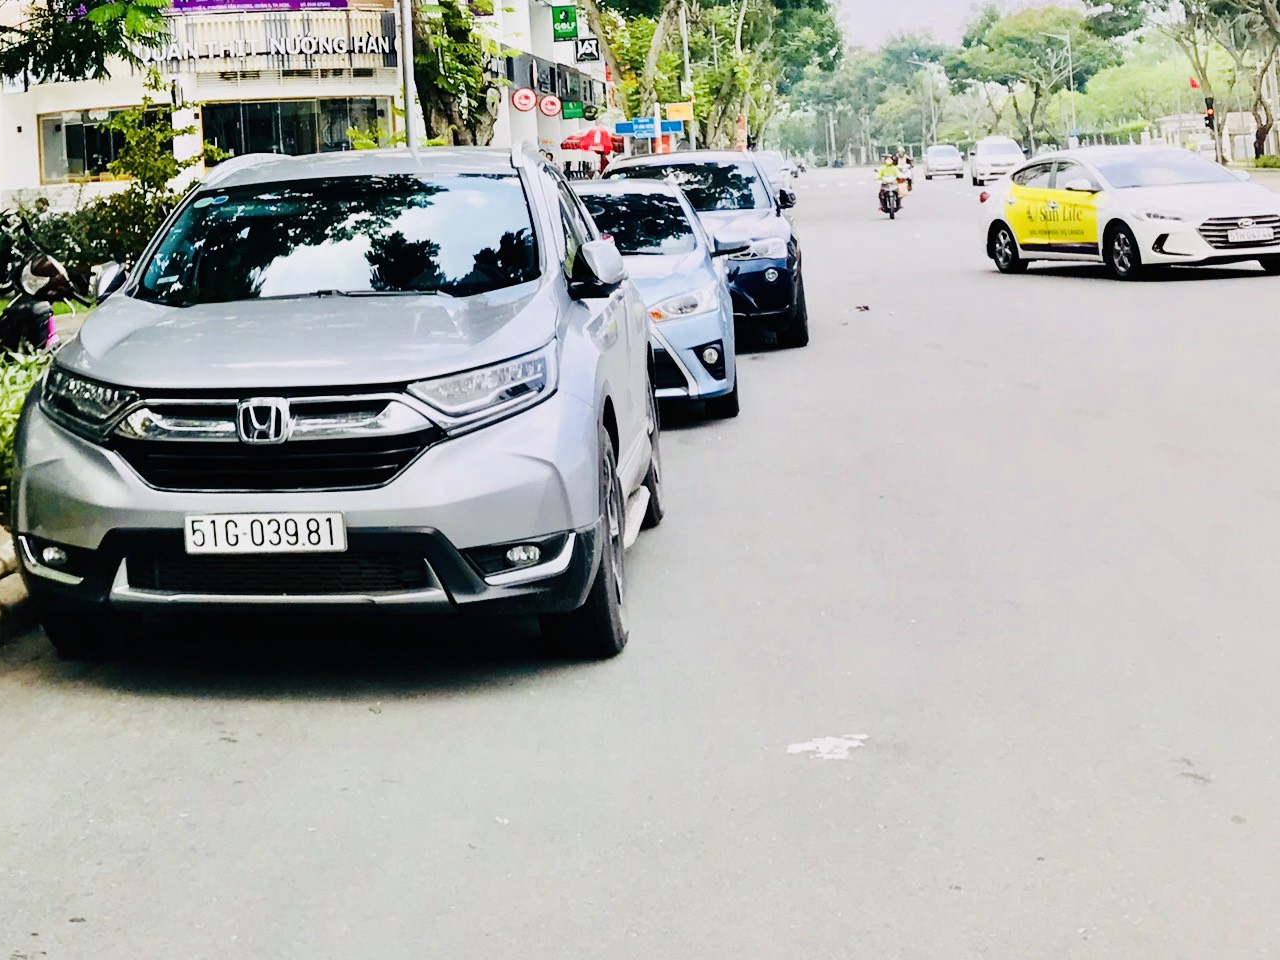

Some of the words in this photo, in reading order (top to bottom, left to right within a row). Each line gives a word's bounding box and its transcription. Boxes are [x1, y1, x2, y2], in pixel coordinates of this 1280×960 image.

[554, 22, 577, 31] GOLF
[204, 38, 260, 62] THỊT
[270, 30, 348, 56] NƯỚNG
[353, 31, 390, 55] HÀN
[1040, 208, 1059, 222] Sun
[1063, 204, 1083, 222] Life
[190, 517, 334, 548] 51G-039.81
